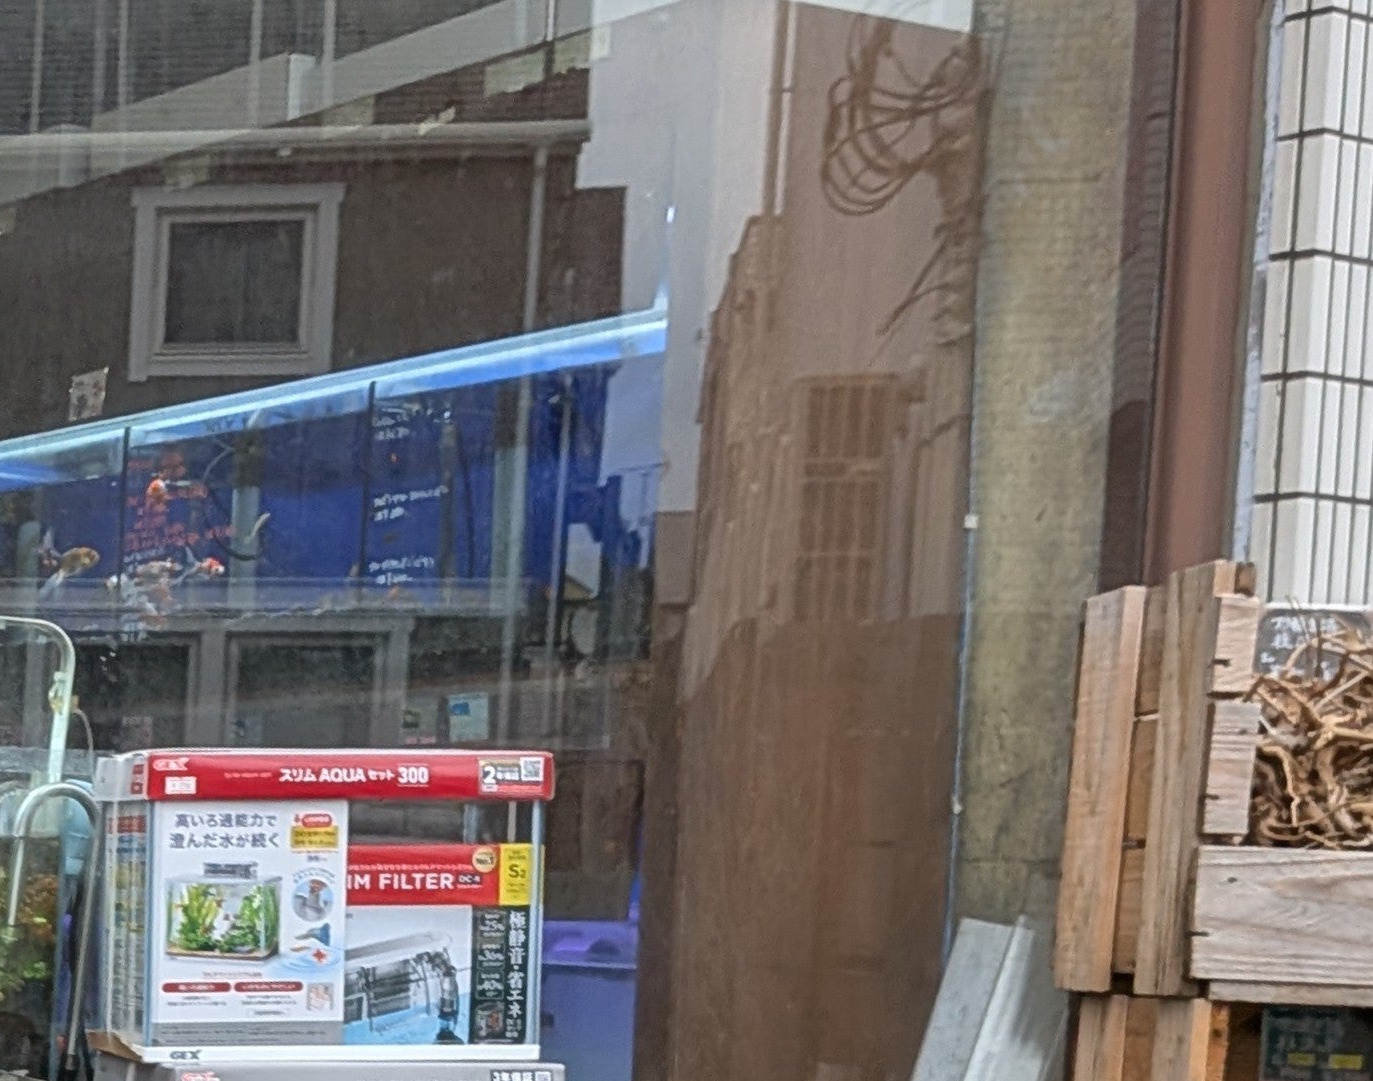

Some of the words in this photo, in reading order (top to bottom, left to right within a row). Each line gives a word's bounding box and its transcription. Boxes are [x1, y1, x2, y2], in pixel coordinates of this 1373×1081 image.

[279, 768, 316, 782] スリム
[318, 768, 366, 782] AQUA
[397, 766, 429, 784] 300
[169, 832, 280, 849] 澄んだ水が続く
[379, 872, 454, 890] FILTER
[169, 1049, 202, 1061] GEX
